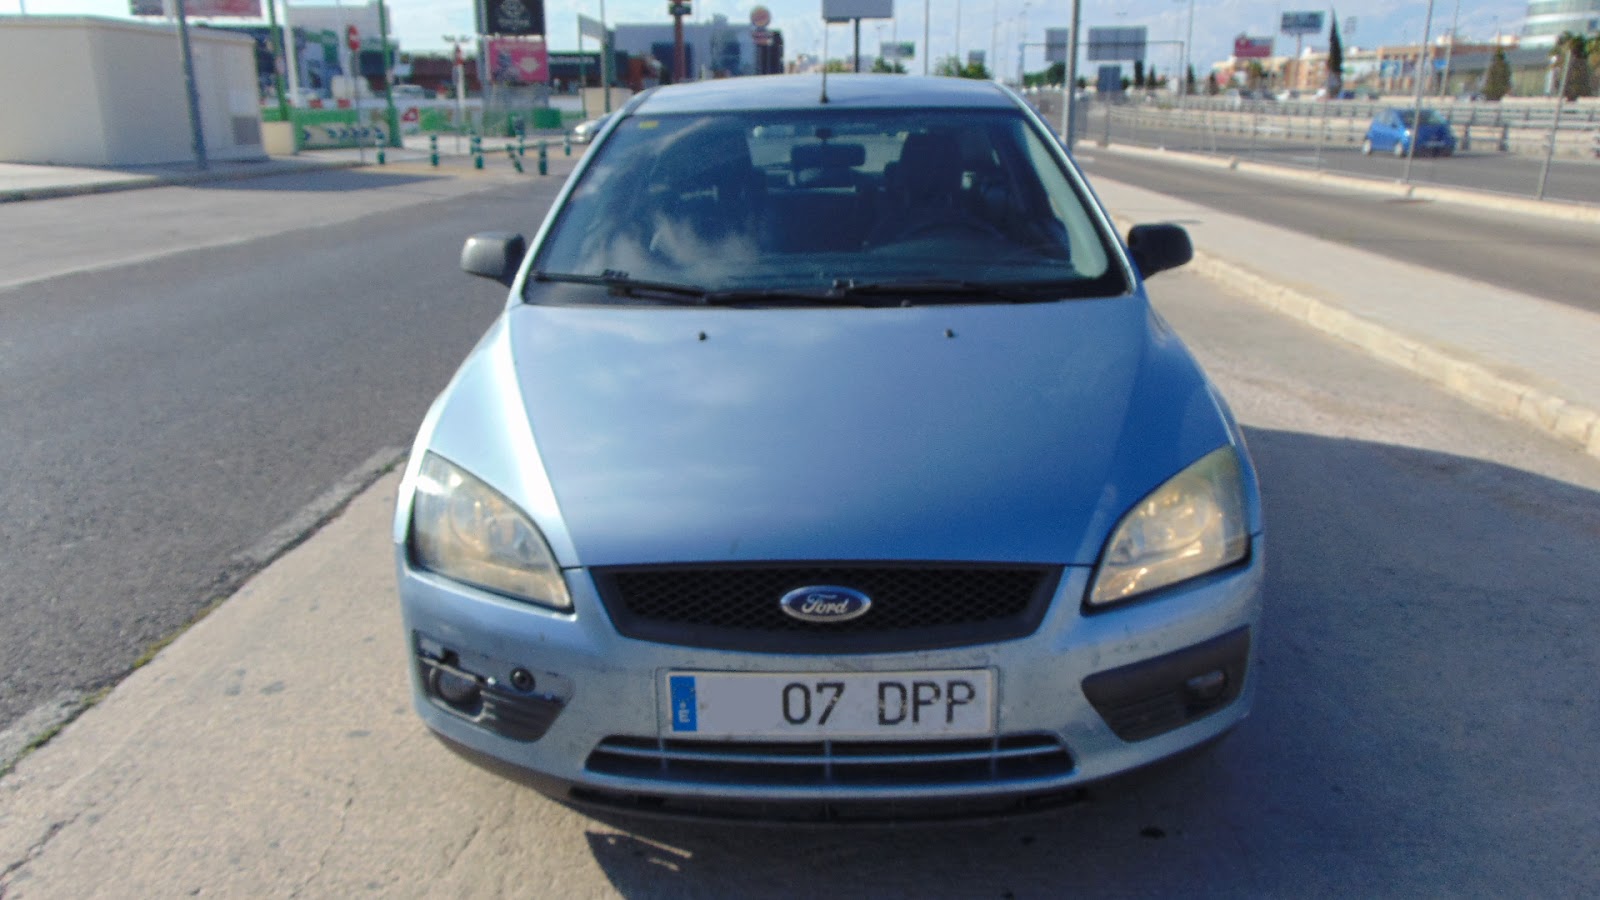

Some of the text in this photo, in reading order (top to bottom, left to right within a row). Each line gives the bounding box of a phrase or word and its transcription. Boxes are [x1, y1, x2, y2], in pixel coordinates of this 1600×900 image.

[801, 594, 850, 614] Ford
[782, 680, 976, 725] 07 DPP
